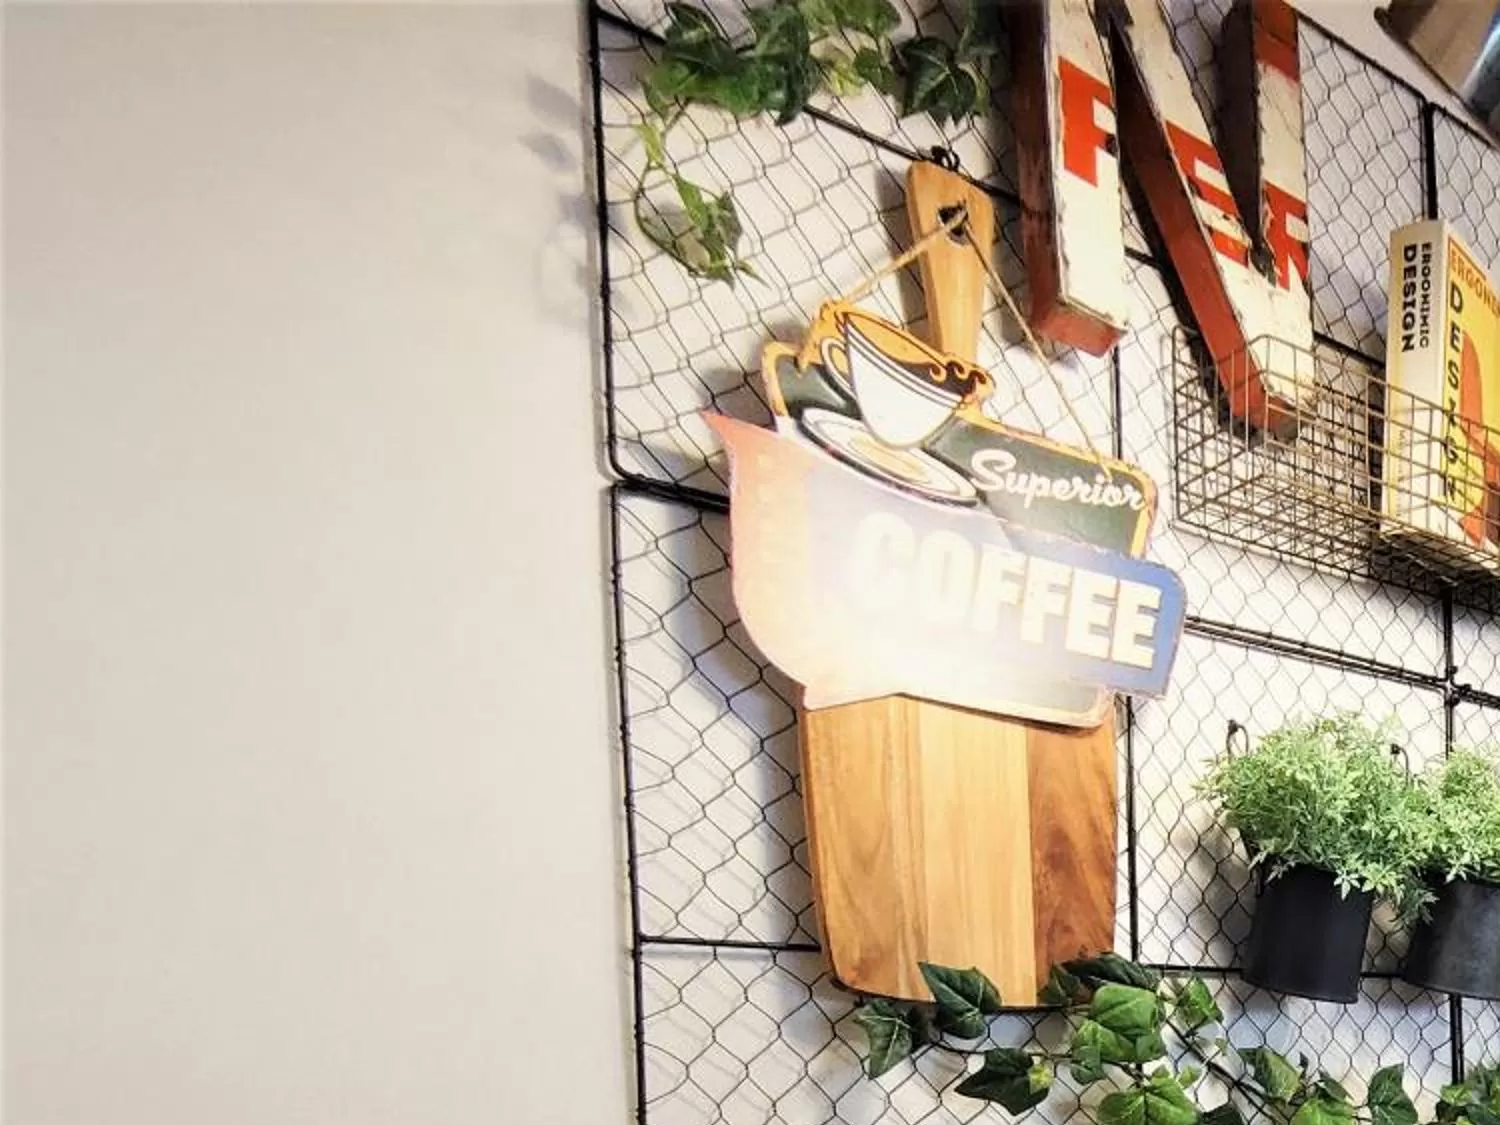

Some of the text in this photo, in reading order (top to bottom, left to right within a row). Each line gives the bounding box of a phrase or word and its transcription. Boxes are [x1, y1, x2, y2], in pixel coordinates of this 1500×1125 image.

[1401, 243, 1417, 352] DESIGN
[971, 449, 1146, 511] Superior
[850, 511, 1162, 671] COFFEE
